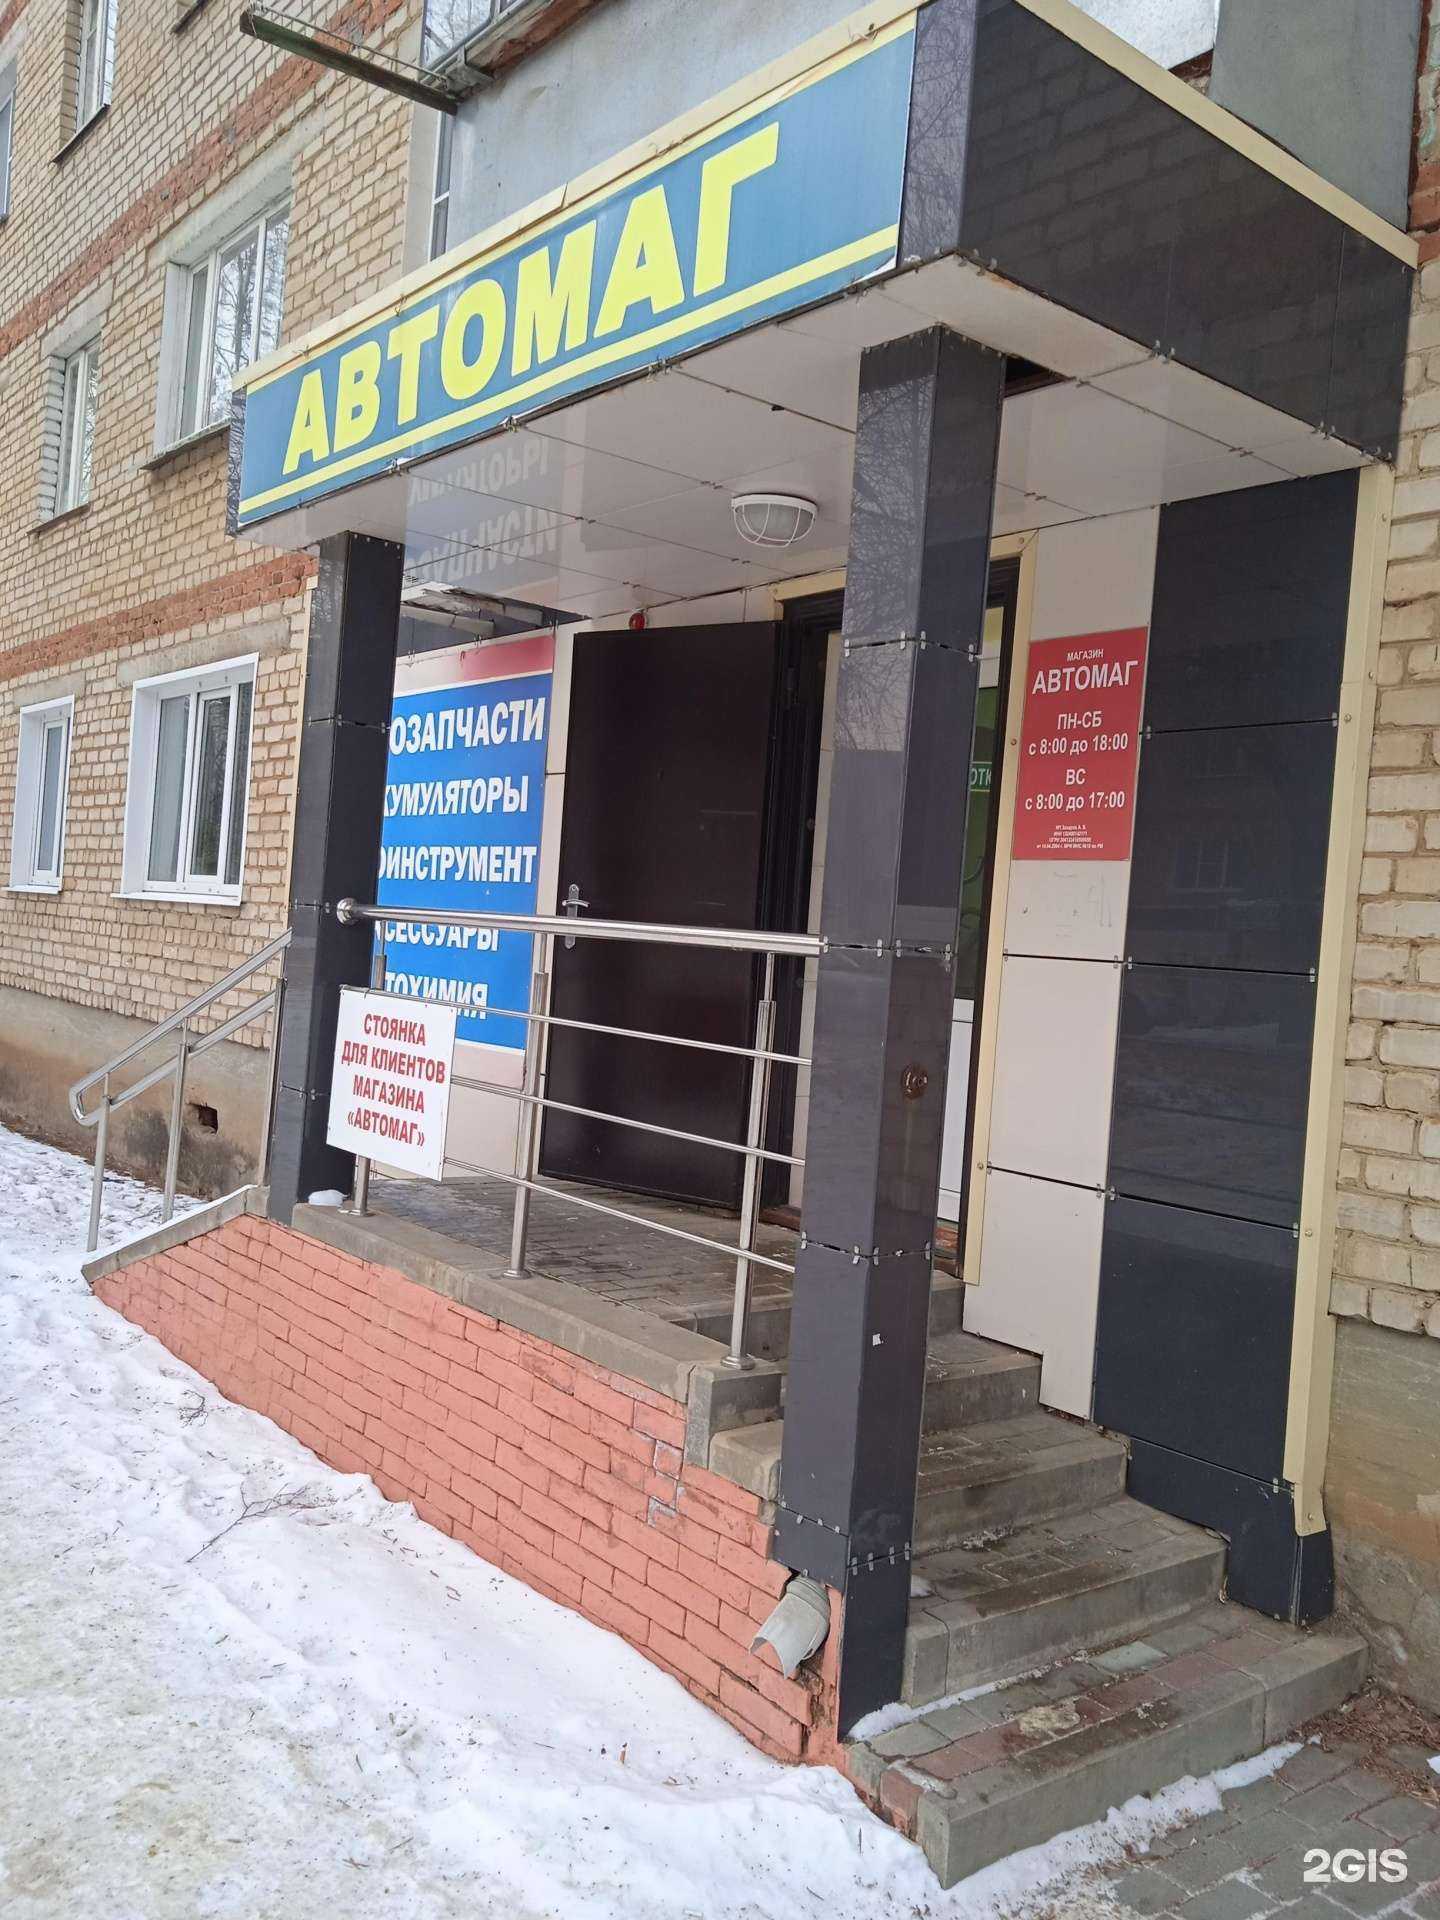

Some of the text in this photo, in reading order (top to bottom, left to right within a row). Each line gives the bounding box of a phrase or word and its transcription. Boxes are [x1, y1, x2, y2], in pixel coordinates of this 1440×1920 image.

[282, 121, 779, 475] АВТОМАГ
[1067, 648, 1105, 661] МАГАЗИН
[1032, 660, 1138, 695] АВТОМАГ
[389, 697, 546, 755] ОЗАПЧАСТИ
[1057, 711, 1102, 730] ПН-СБ
[1028, 732, 1129, 756] с 8:00 до 18:00
[1065, 768, 1086, 786] ВС
[1025, 791, 1125, 812] с 8:00 до 17:00
[375, 920, 500, 951] СЕССУАРЫ
[364, 1013, 426, 1046] СТОЯНКА
[341, 1040, 446, 1084] ДЛЯ КЛИЕНТОВ
[353, 1074, 425, 1114] МАГАЗИНА
[347, 1107, 425, 1147] «АВТОМАГ»
